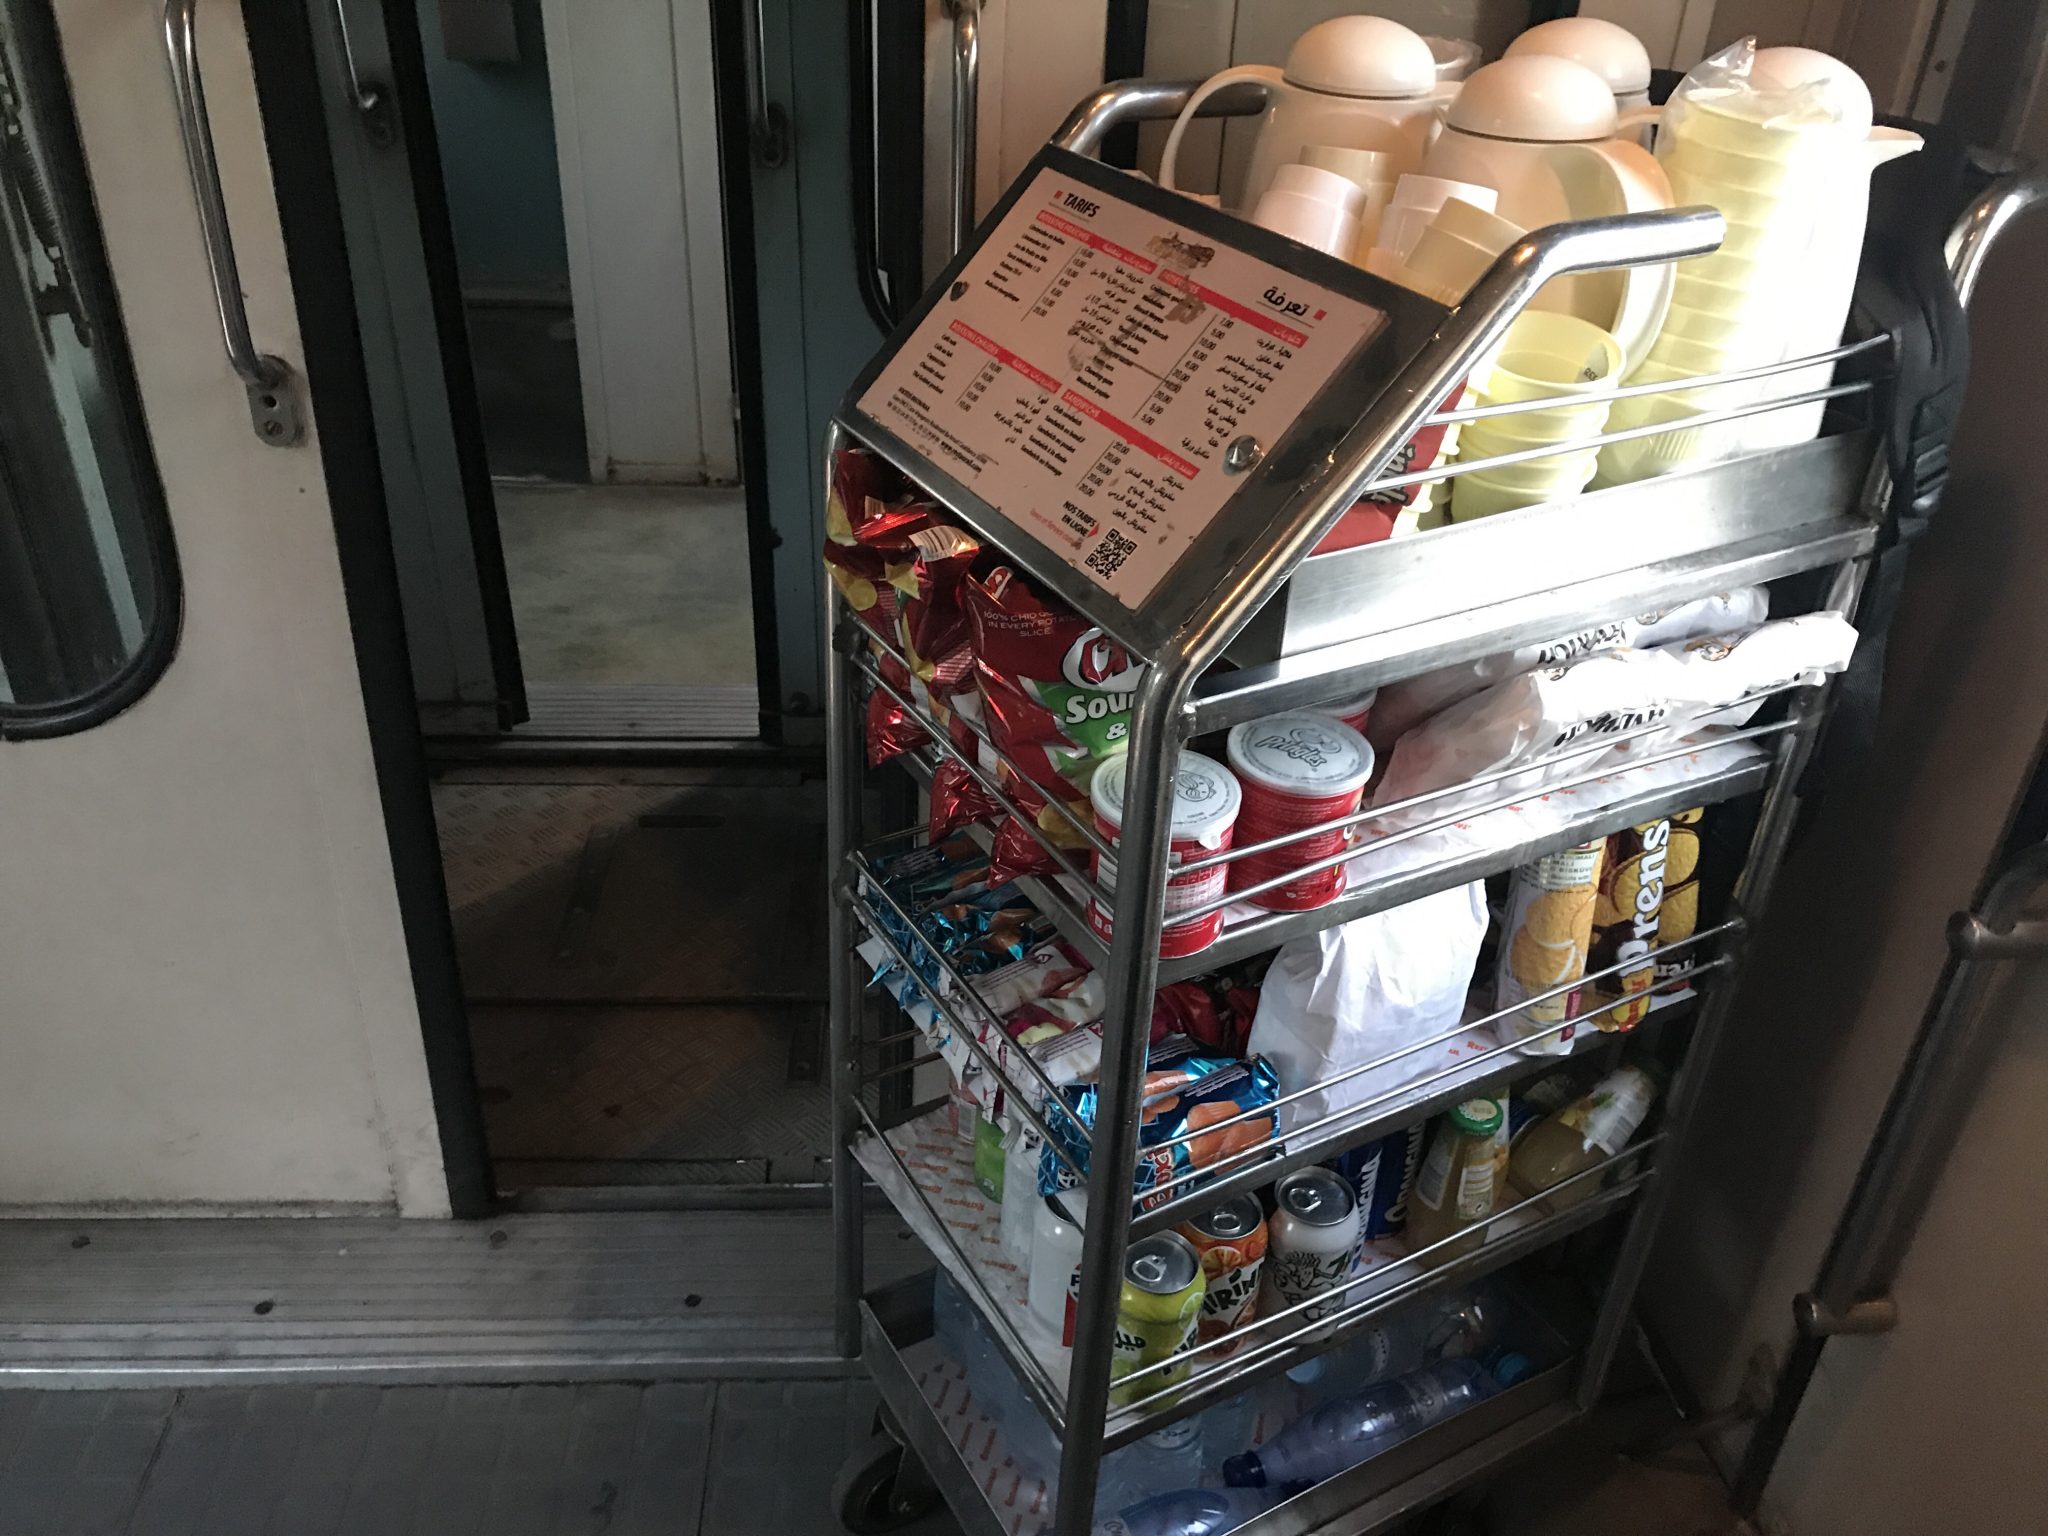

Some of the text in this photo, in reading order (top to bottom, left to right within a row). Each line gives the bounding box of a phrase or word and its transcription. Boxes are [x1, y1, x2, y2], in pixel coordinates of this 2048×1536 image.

[1062, 191, 1101, 218] TARIFS
[1262, 285, 1311, 317] تعرفة
[1060, 513, 1073, 525] EN
[1061, 499, 1098, 528] NOS TARIFS
[1019, 628, 1053, 637] SLICE
[1105, 722, 1128, 741] &
[1255, 735, 1328, 767] Pringles
[1615, 818, 1671, 978] Prens
